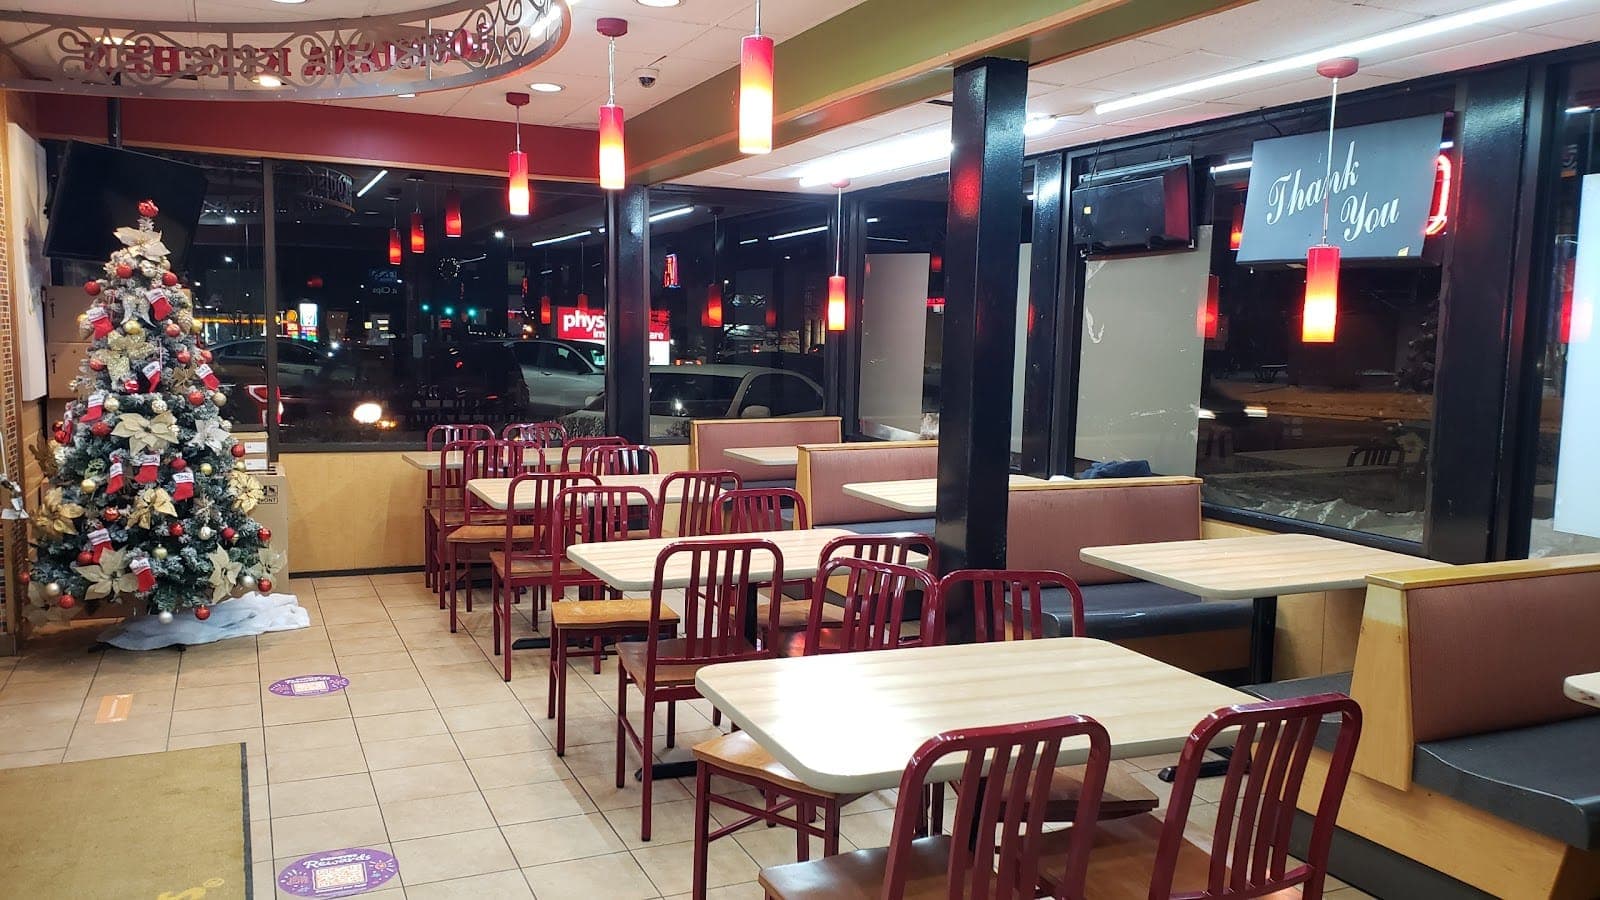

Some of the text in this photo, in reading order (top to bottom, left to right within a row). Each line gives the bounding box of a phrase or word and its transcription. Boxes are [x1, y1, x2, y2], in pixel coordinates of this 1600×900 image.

[1266, 141, 1360, 225] Thank
[1340, 191, 1400, 242] You
[563, 309, 606, 332] phys
[302, 853, 371, 869] Rewards
